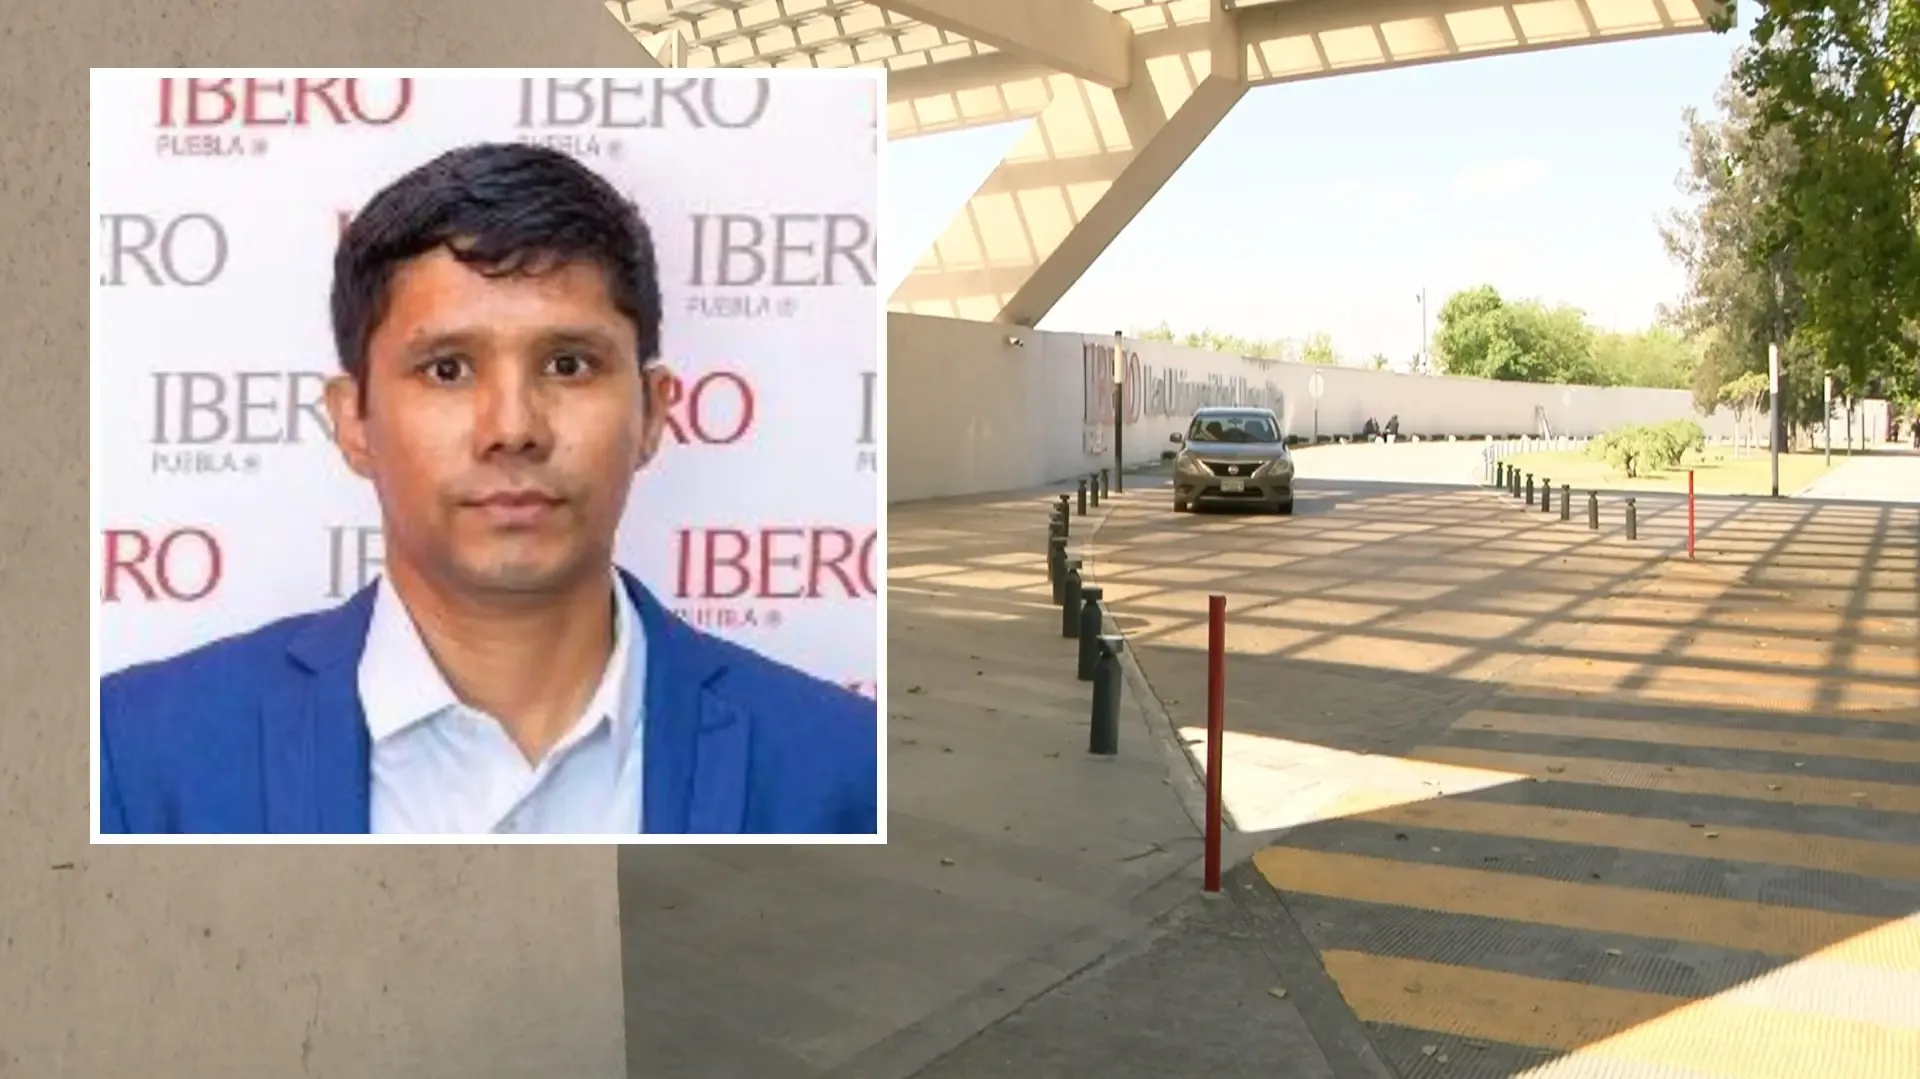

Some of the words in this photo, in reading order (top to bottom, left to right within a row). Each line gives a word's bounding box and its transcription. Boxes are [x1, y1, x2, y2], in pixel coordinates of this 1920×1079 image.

[154, 78, 413, 128] IBERO
[514, 78, 770, 129] IBERO
[156, 136, 244, 157] PUEBLA
[100, 212, 229, 287] RO
[687, 213, 877, 287] IBER
[686, 297, 770, 318] PUEBLA
[152, 452, 236, 473] PUEBLA
